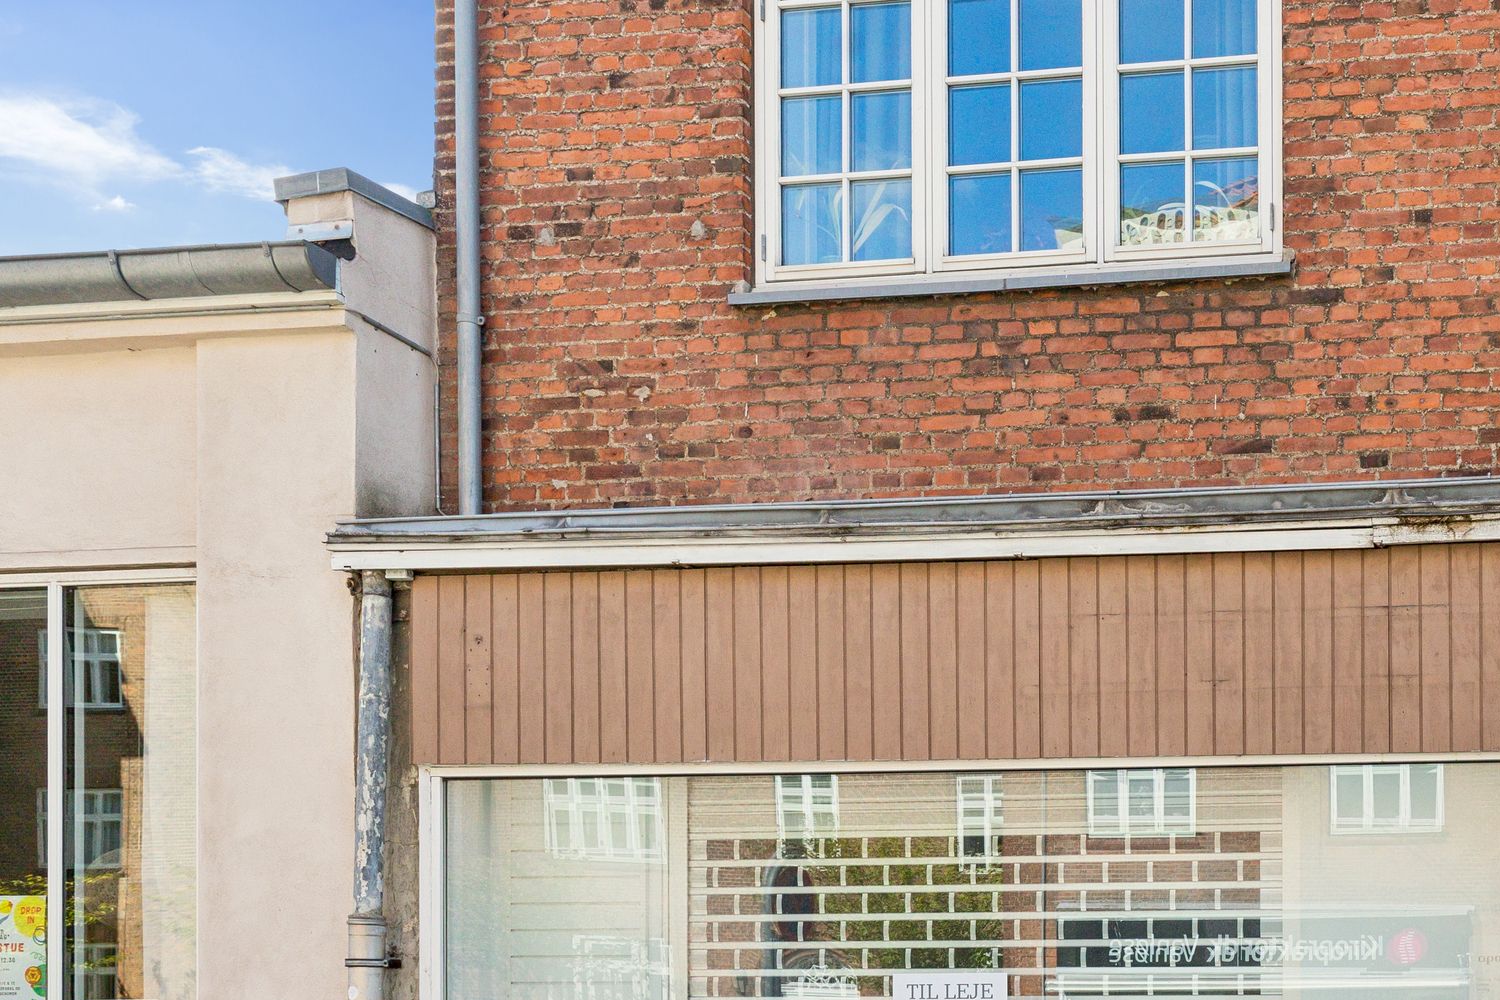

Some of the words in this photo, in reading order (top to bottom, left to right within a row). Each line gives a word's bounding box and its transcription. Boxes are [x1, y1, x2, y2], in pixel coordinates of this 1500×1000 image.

[27, 916, 35, 924] IN
[907, 983, 939, 1000] TIL
[944, 983, 994, 1000] LEJE
